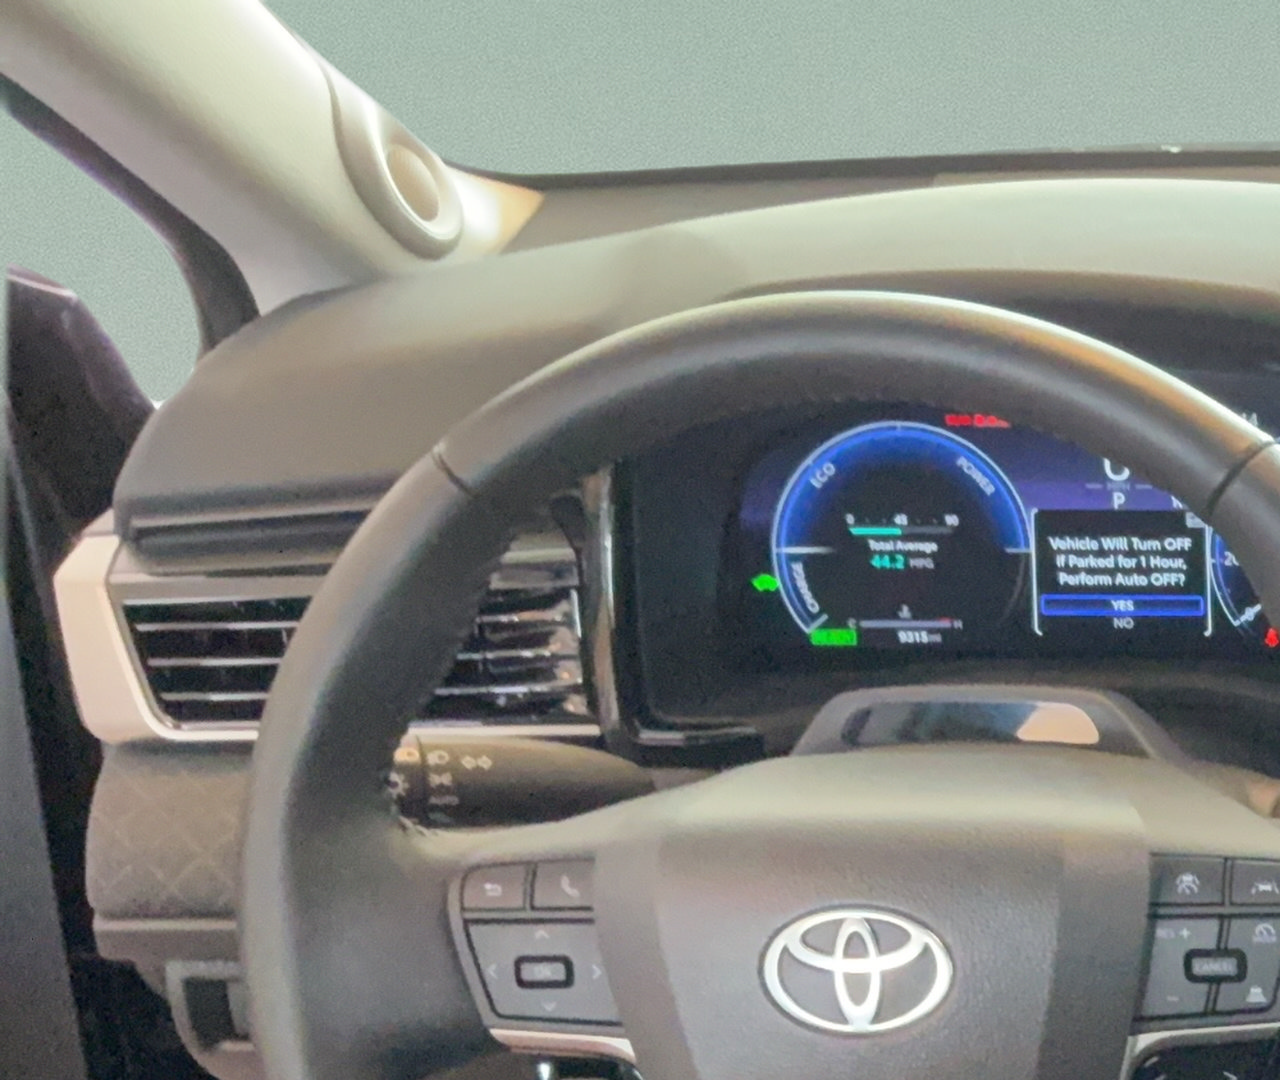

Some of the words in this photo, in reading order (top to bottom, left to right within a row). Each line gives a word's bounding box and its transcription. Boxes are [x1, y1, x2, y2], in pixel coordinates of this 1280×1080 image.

[810, 462, 836, 489] ECO
[955, 456, 996, 496] POWER
[1113, 492, 1126, 510] P
[867, 539, 895, 551] Total
[895, 540, 938, 554] Average
[1048, 537, 1099, 551] Vehicle
[1101, 537, 1130, 551] Will
[1131, 537, 1161, 551] Turn
[1164, 538, 1192, 551] OFF
[870, 554, 905, 569] 44.2
[1056, 554, 1067, 568] If
[1068, 554, 1115, 568] Parked
[1117, 554, 1138, 568] for
[1150, 555, 1188, 570] Hour,
[1057, 571, 1112, 586] Perform
[1115, 572, 1148, 586] Auto
[1151, 572, 1186, 587] OFF?
[1111, 600, 1134, 611] YES
[1113, 618, 1135, 629] NO
